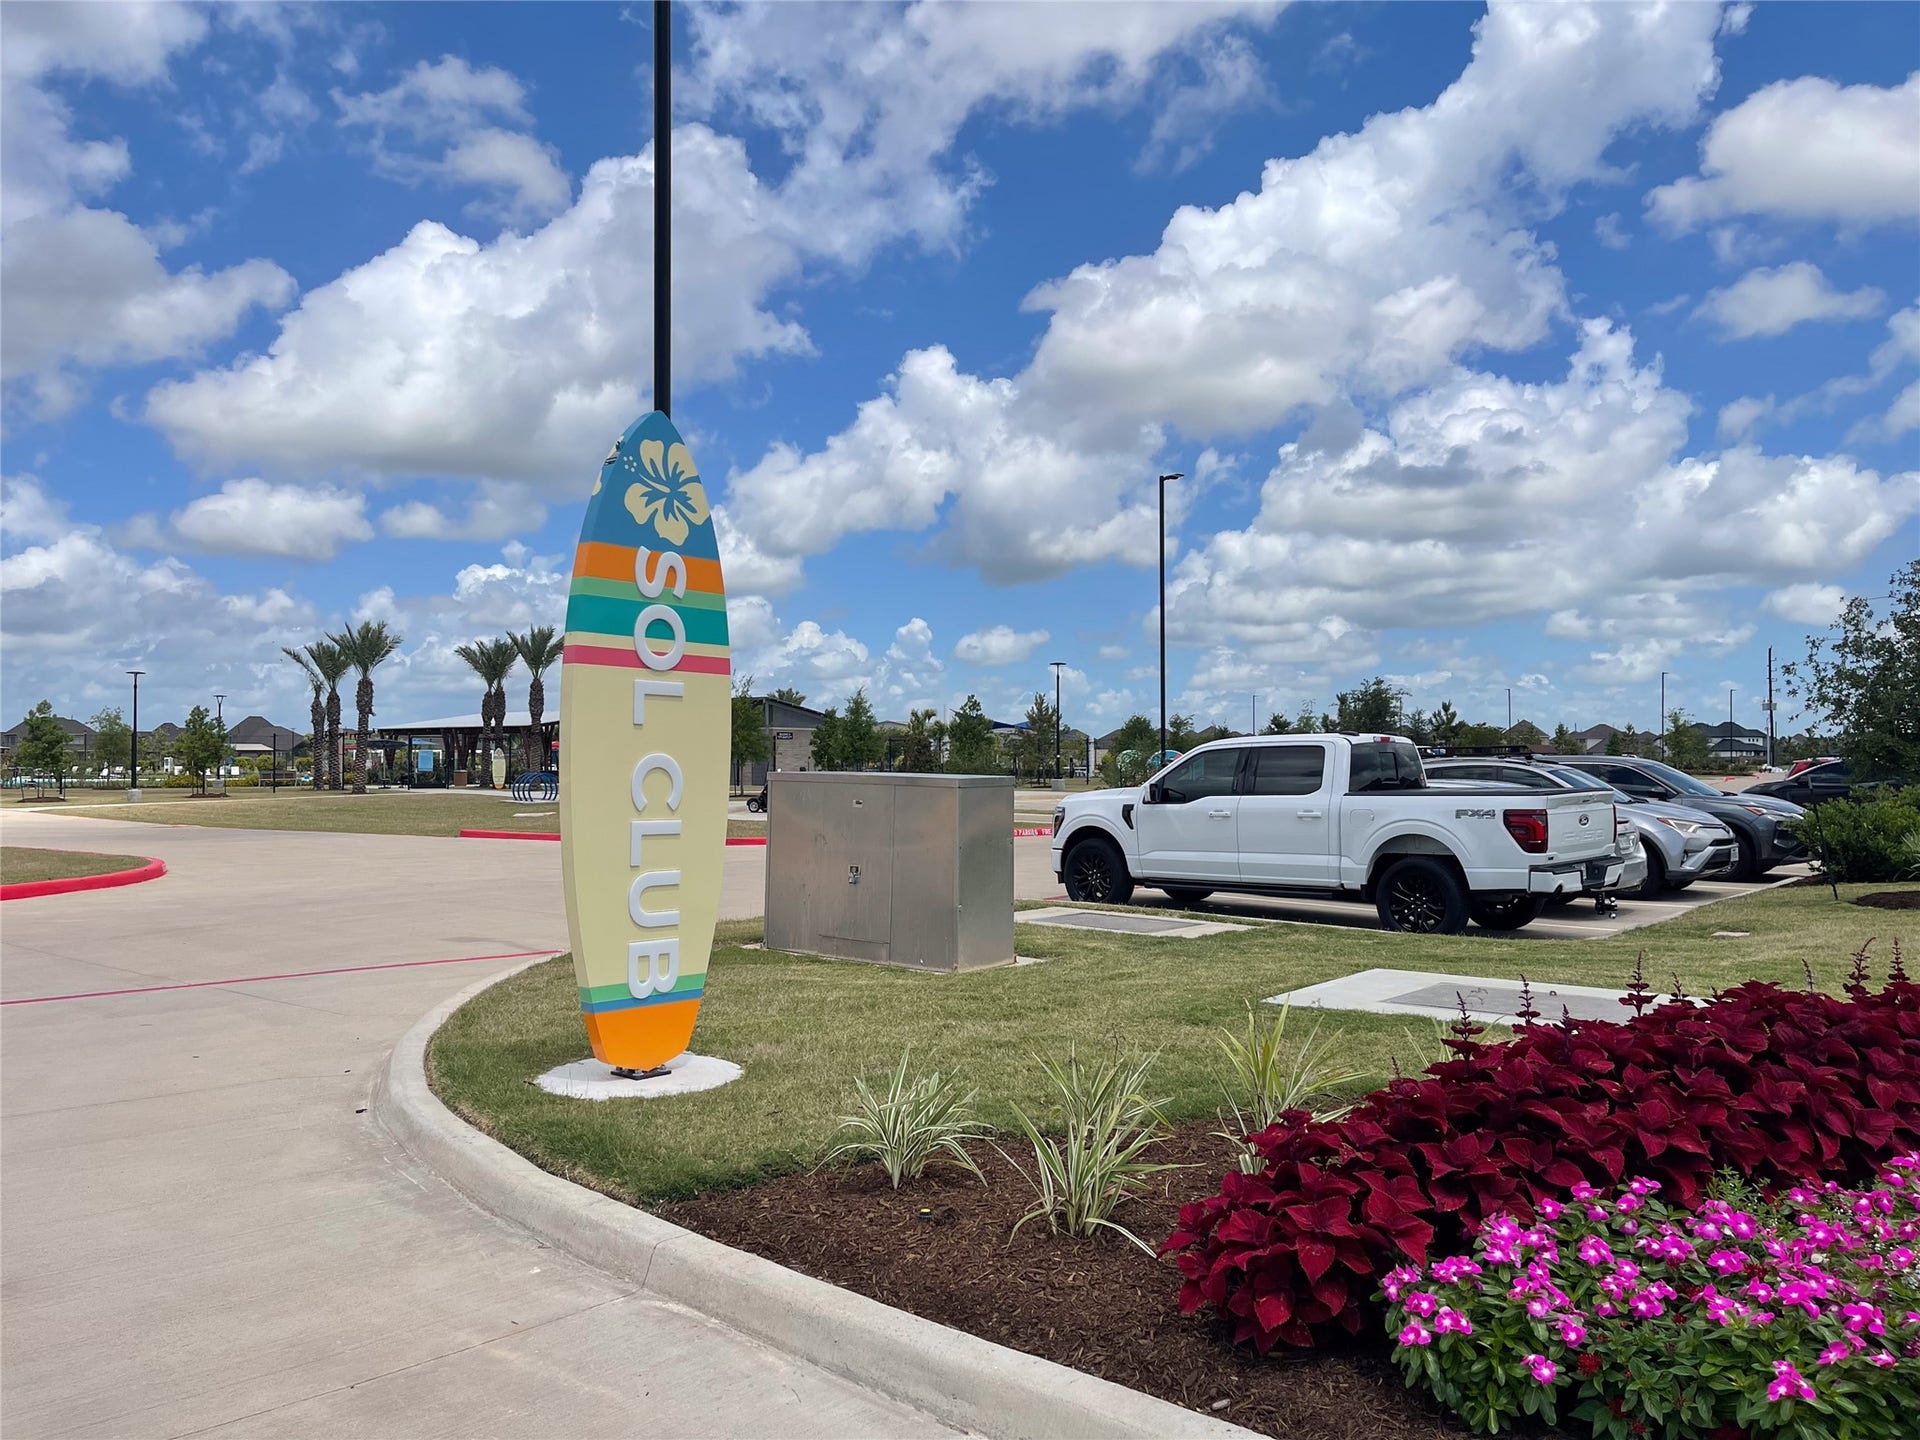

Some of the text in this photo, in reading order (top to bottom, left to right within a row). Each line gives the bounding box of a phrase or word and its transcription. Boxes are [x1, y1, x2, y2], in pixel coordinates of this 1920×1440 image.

[627, 546, 687, 999] SOL CLUB
[1456, 809, 1496, 819] FX4
